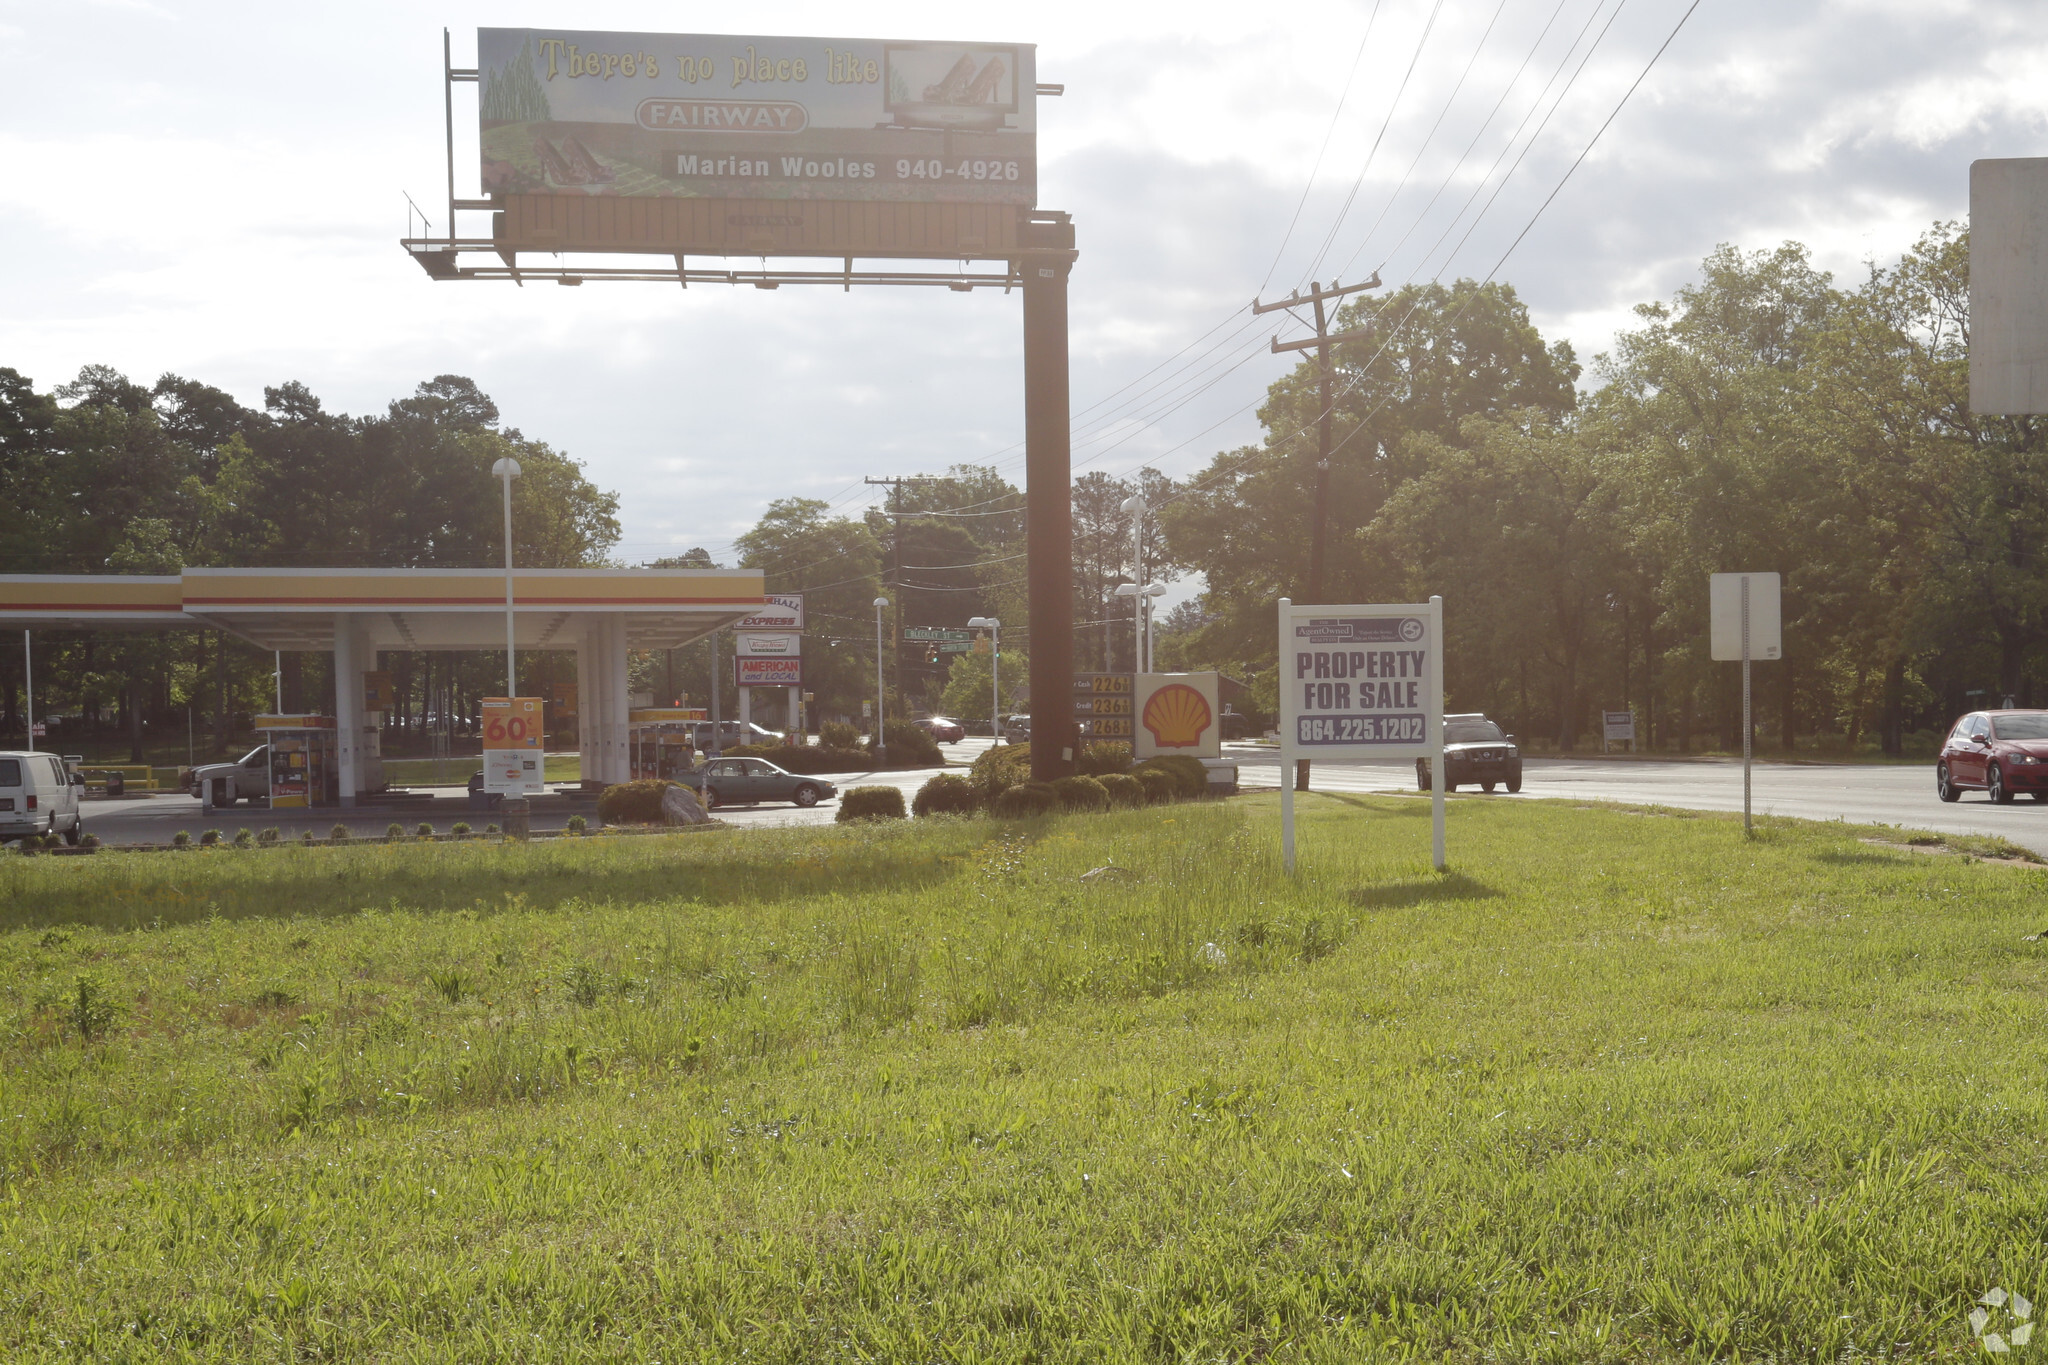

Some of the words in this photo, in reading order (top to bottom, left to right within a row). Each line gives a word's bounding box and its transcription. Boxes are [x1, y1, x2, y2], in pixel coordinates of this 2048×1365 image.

[538, 38, 660, 82] There's
[677, 55, 714, 84] no
[730, 46, 808, 88] place
[825, 47, 879, 84] like
[650, 105, 793, 128] FAIRWAY
[677, 155, 769, 177] Marian
[781, 157, 876, 179] Wooles
[896, 159, 1019, 181] 940-4926
[771, 597, 800, 611] HALL
[742, 617, 796, 626] EXPRESS
[1298, 626, 1350, 636] AgentOwned
[742, 661, 798, 672] AMERICAN
[1297, 651, 1425, 679] PROPERTY
[745, 672, 762, 680] and
[765, 672, 797, 680] LOCAL
[1095, 677, 1121, 691] 226
[1305, 682, 1351, 709] FOR
[1359, 682, 1418, 709] SALE
[1095, 699, 1121, 713] 236
[1095, 720, 1120, 734] 268
[1300, 718, 1422, 741] 864.225.1202
